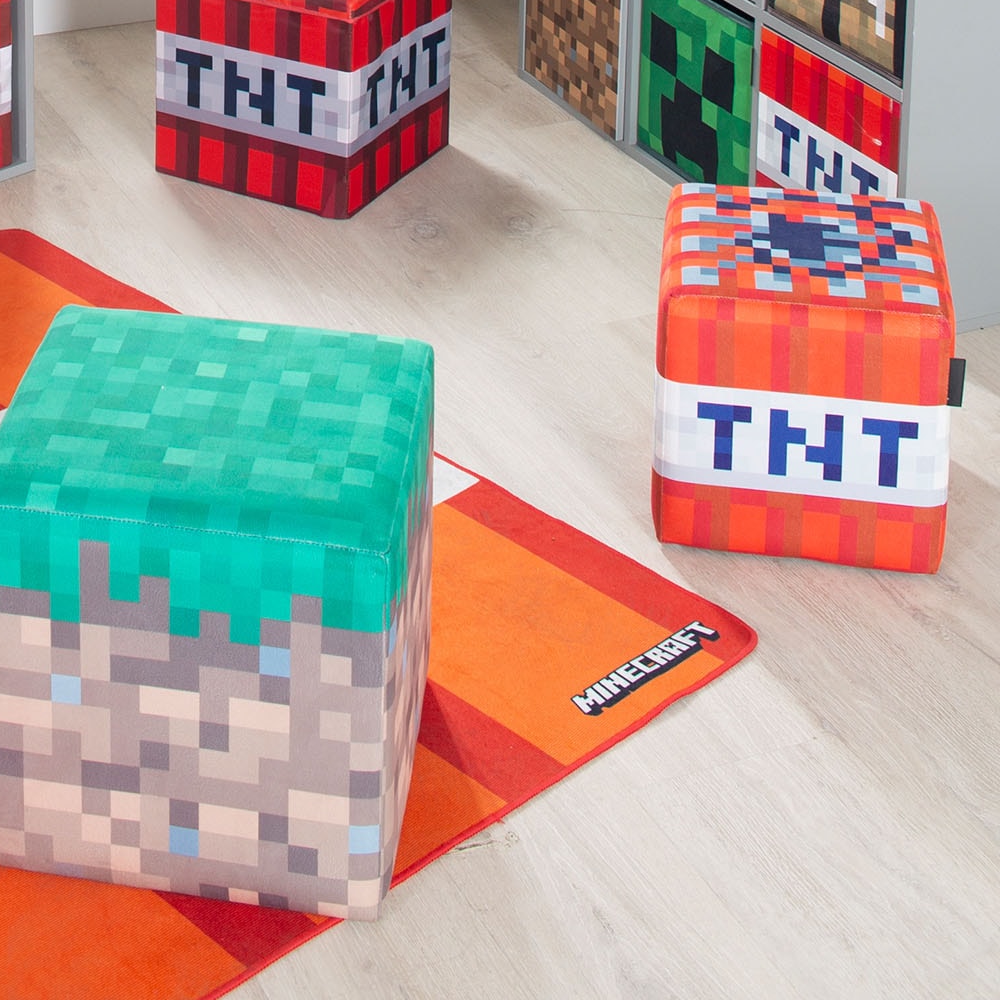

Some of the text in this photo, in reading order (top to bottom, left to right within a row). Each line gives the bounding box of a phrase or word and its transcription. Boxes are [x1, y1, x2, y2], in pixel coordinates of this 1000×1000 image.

[176, 48, 326, 136] TNT
[367, 27, 446, 129] TNT
[697, 401, 919, 488] TNT
[571, 620, 720, 716] MINECRAFT
